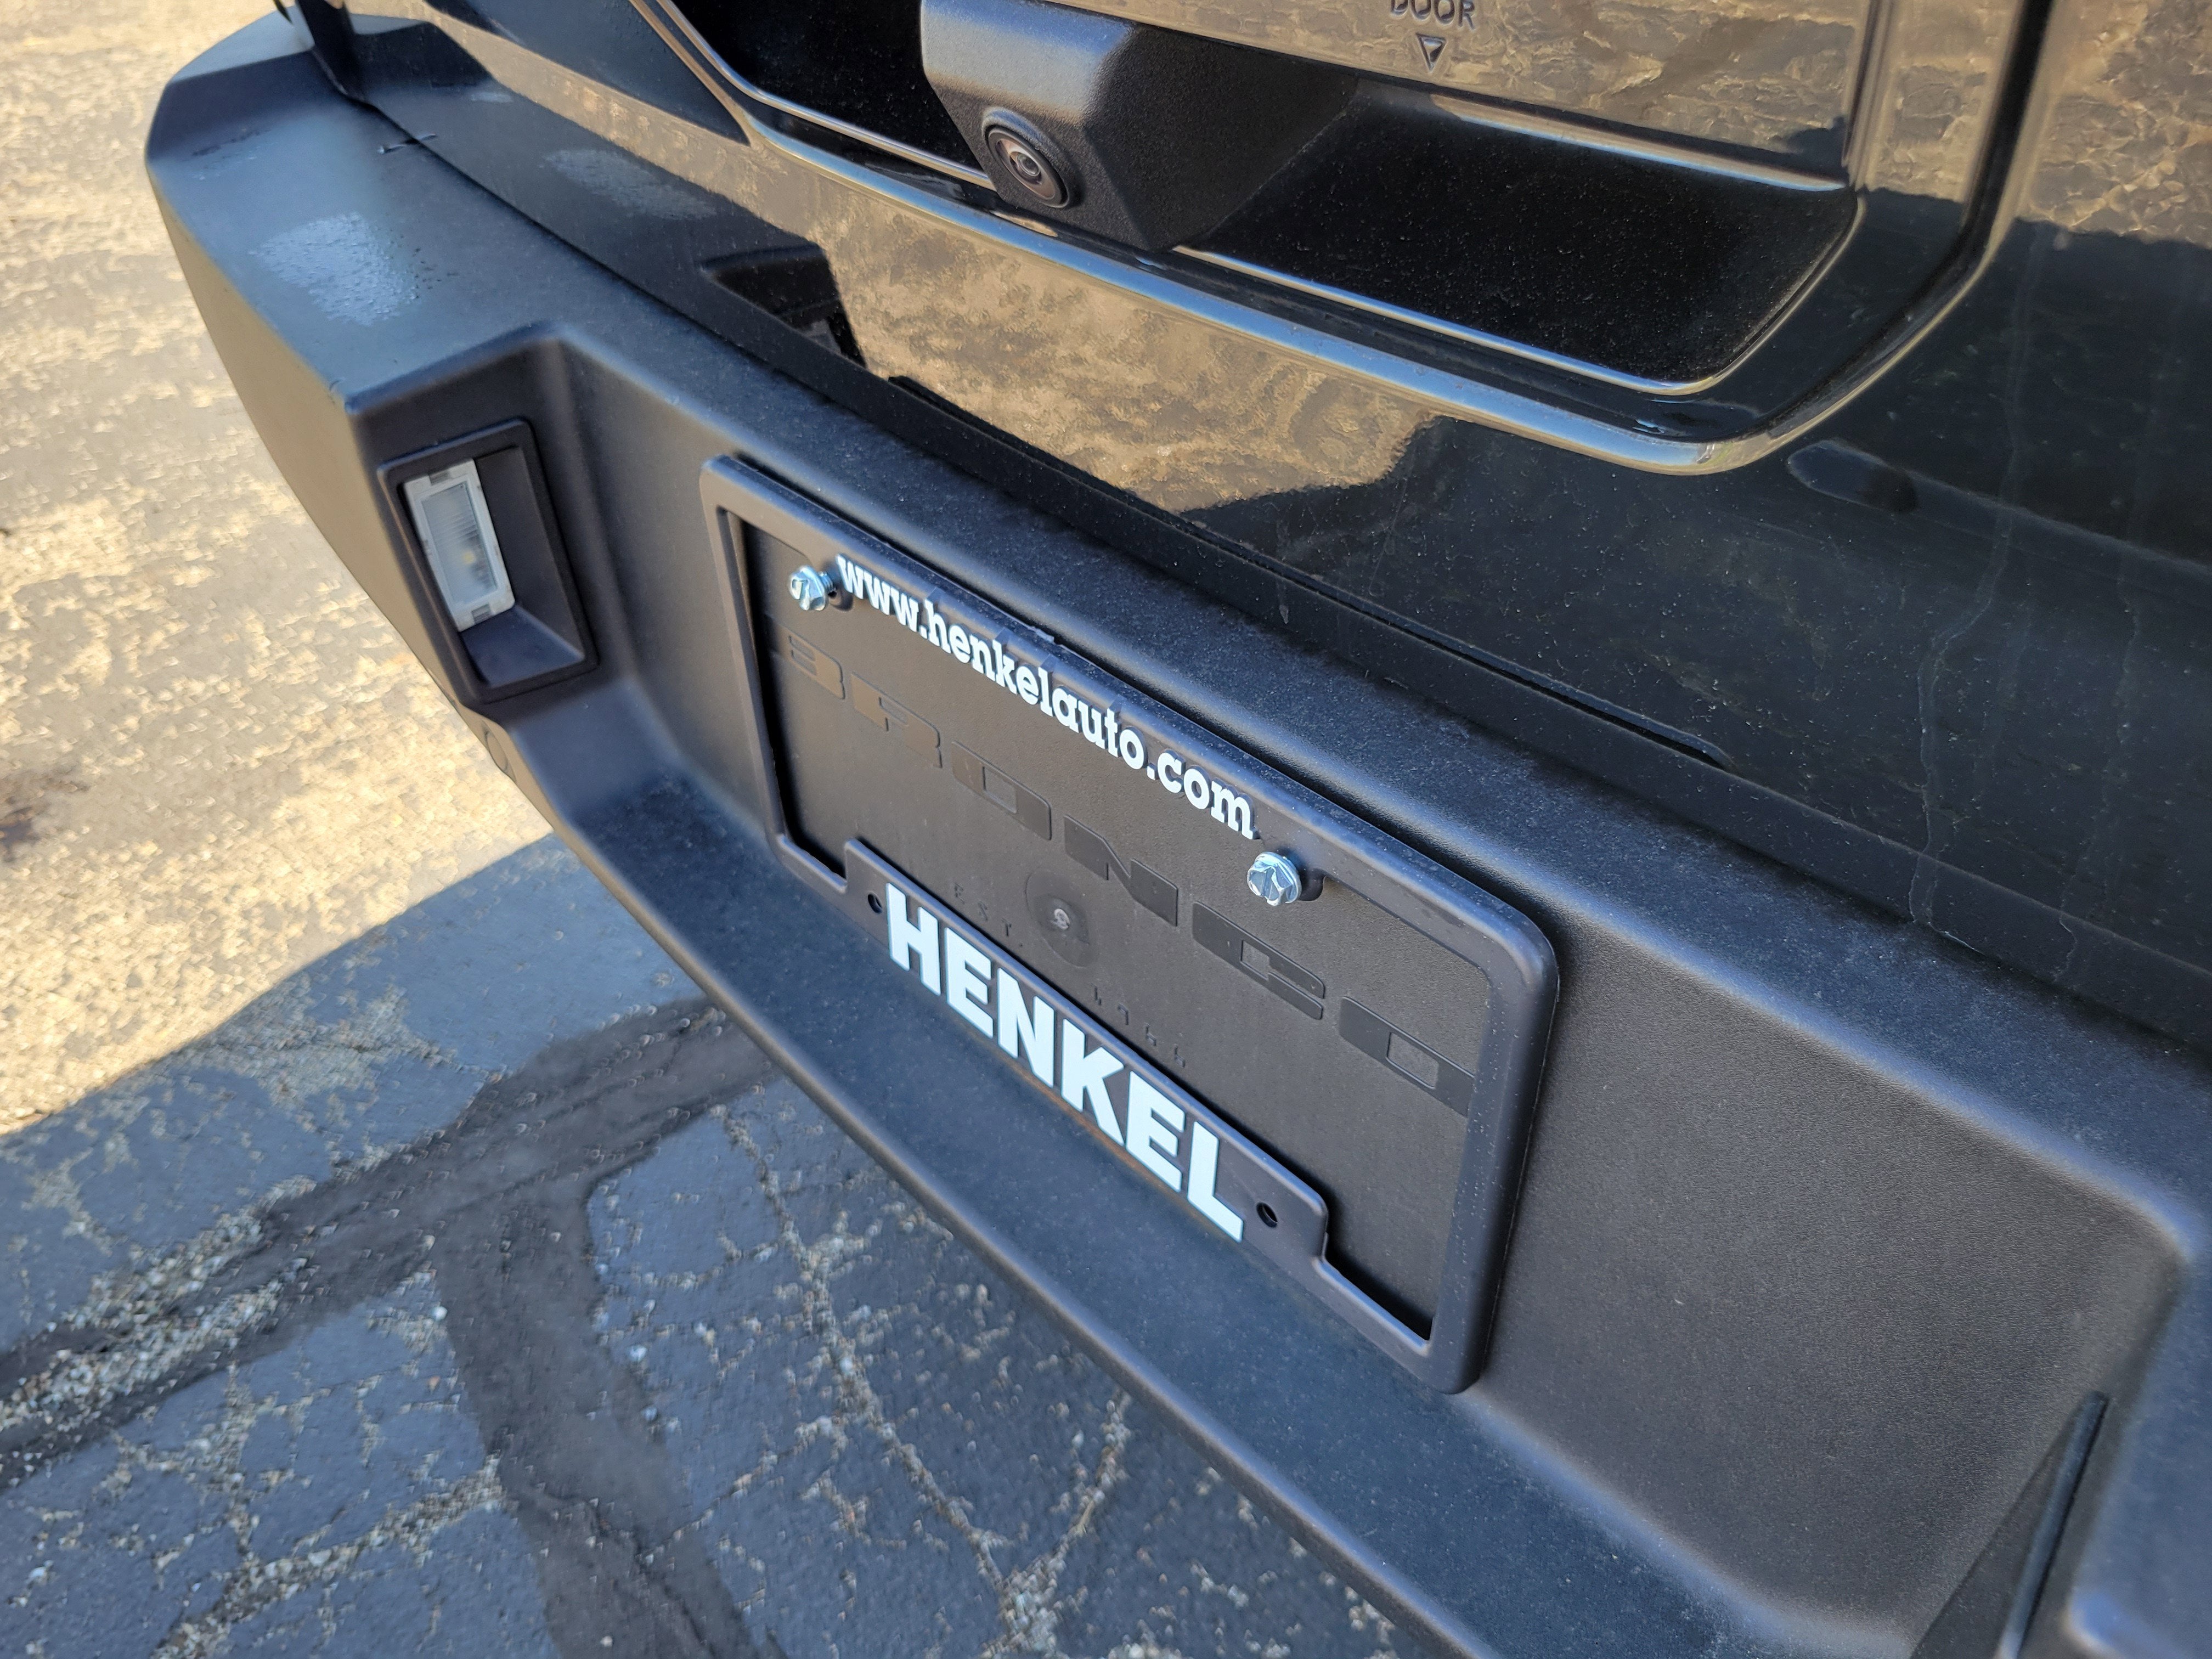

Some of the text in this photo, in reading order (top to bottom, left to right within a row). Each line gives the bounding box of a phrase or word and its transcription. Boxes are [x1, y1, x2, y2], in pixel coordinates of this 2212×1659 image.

[774, 623, 1474, 1118] BRONCO
[836, 554, 1254, 840] www.henkelauto.com
[885, 882, 1244, 1243] HENKEL
